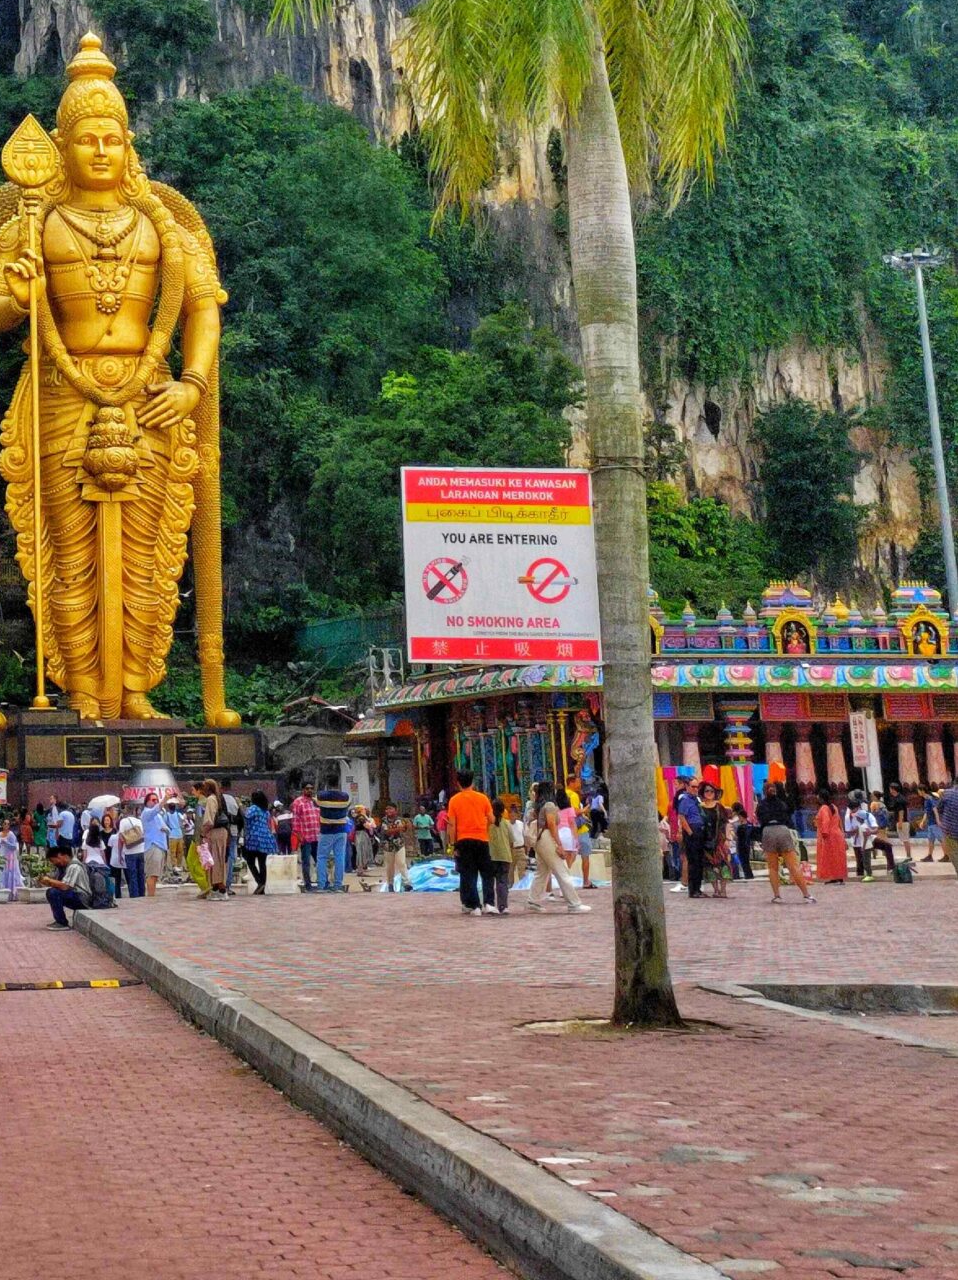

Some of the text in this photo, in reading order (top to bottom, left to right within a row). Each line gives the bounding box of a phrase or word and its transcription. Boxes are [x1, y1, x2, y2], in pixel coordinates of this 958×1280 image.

[418, 477, 576, 489] ANDA MEMASUKI KE KAWASAN
[441, 490, 554, 500] LARANGAN MEROKOK
[442, 533, 558, 545] YOU ARE ENTERING
[447, 616, 560, 628] NO SMOKING AREA
[431, 640, 573, 657] 禁止吸烟
